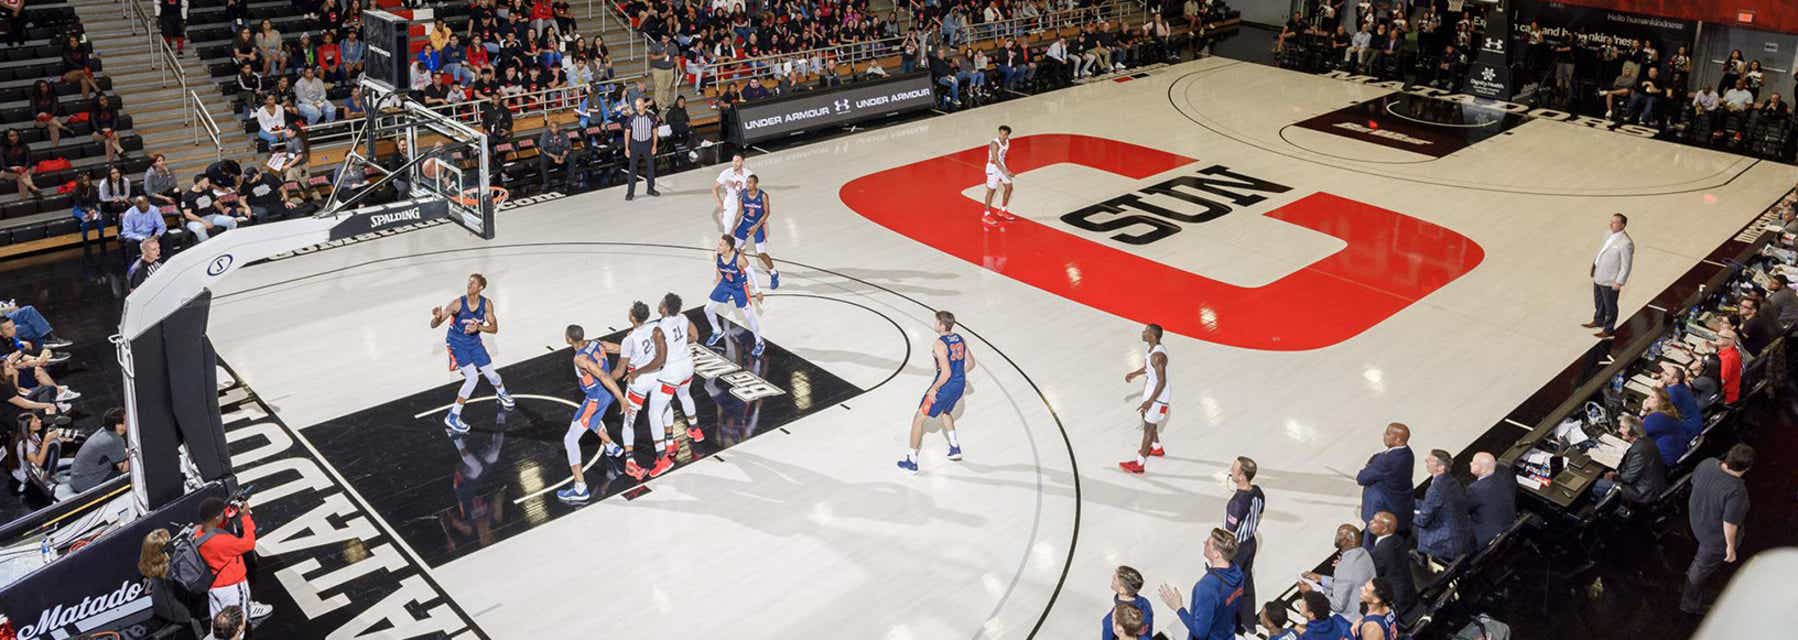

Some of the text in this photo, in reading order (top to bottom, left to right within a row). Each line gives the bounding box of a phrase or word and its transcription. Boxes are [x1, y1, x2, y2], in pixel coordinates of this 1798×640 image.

[1541, 26, 1560, 37] and
[855, 88, 930, 109] UNDER ARMOUR
[744, 106, 830, 130] UNDER ARMOUR
[370, 207, 421, 228] SPALDING
[672, 325, 684, 343] 11
